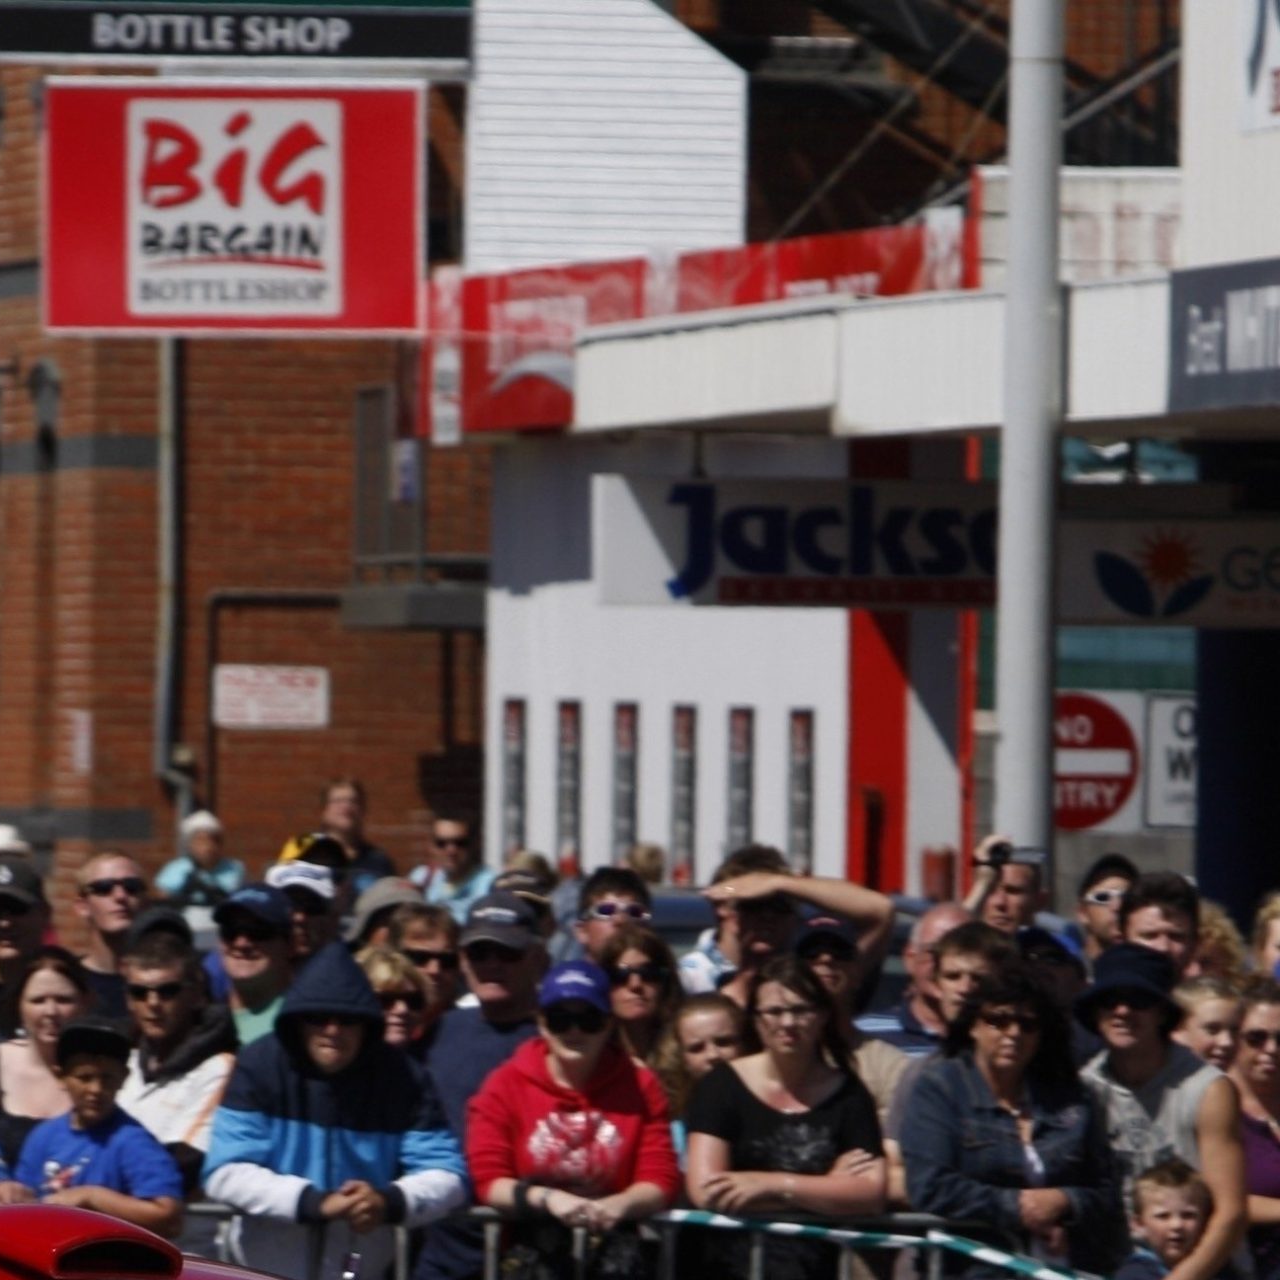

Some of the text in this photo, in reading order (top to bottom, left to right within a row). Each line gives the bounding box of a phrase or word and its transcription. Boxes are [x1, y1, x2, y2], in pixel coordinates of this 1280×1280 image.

[92, 13, 353, 51] BOTTLE SHOP
[141, 221, 322, 259] BARGAIN
[139, 278, 328, 304] BOTTLESHOP
